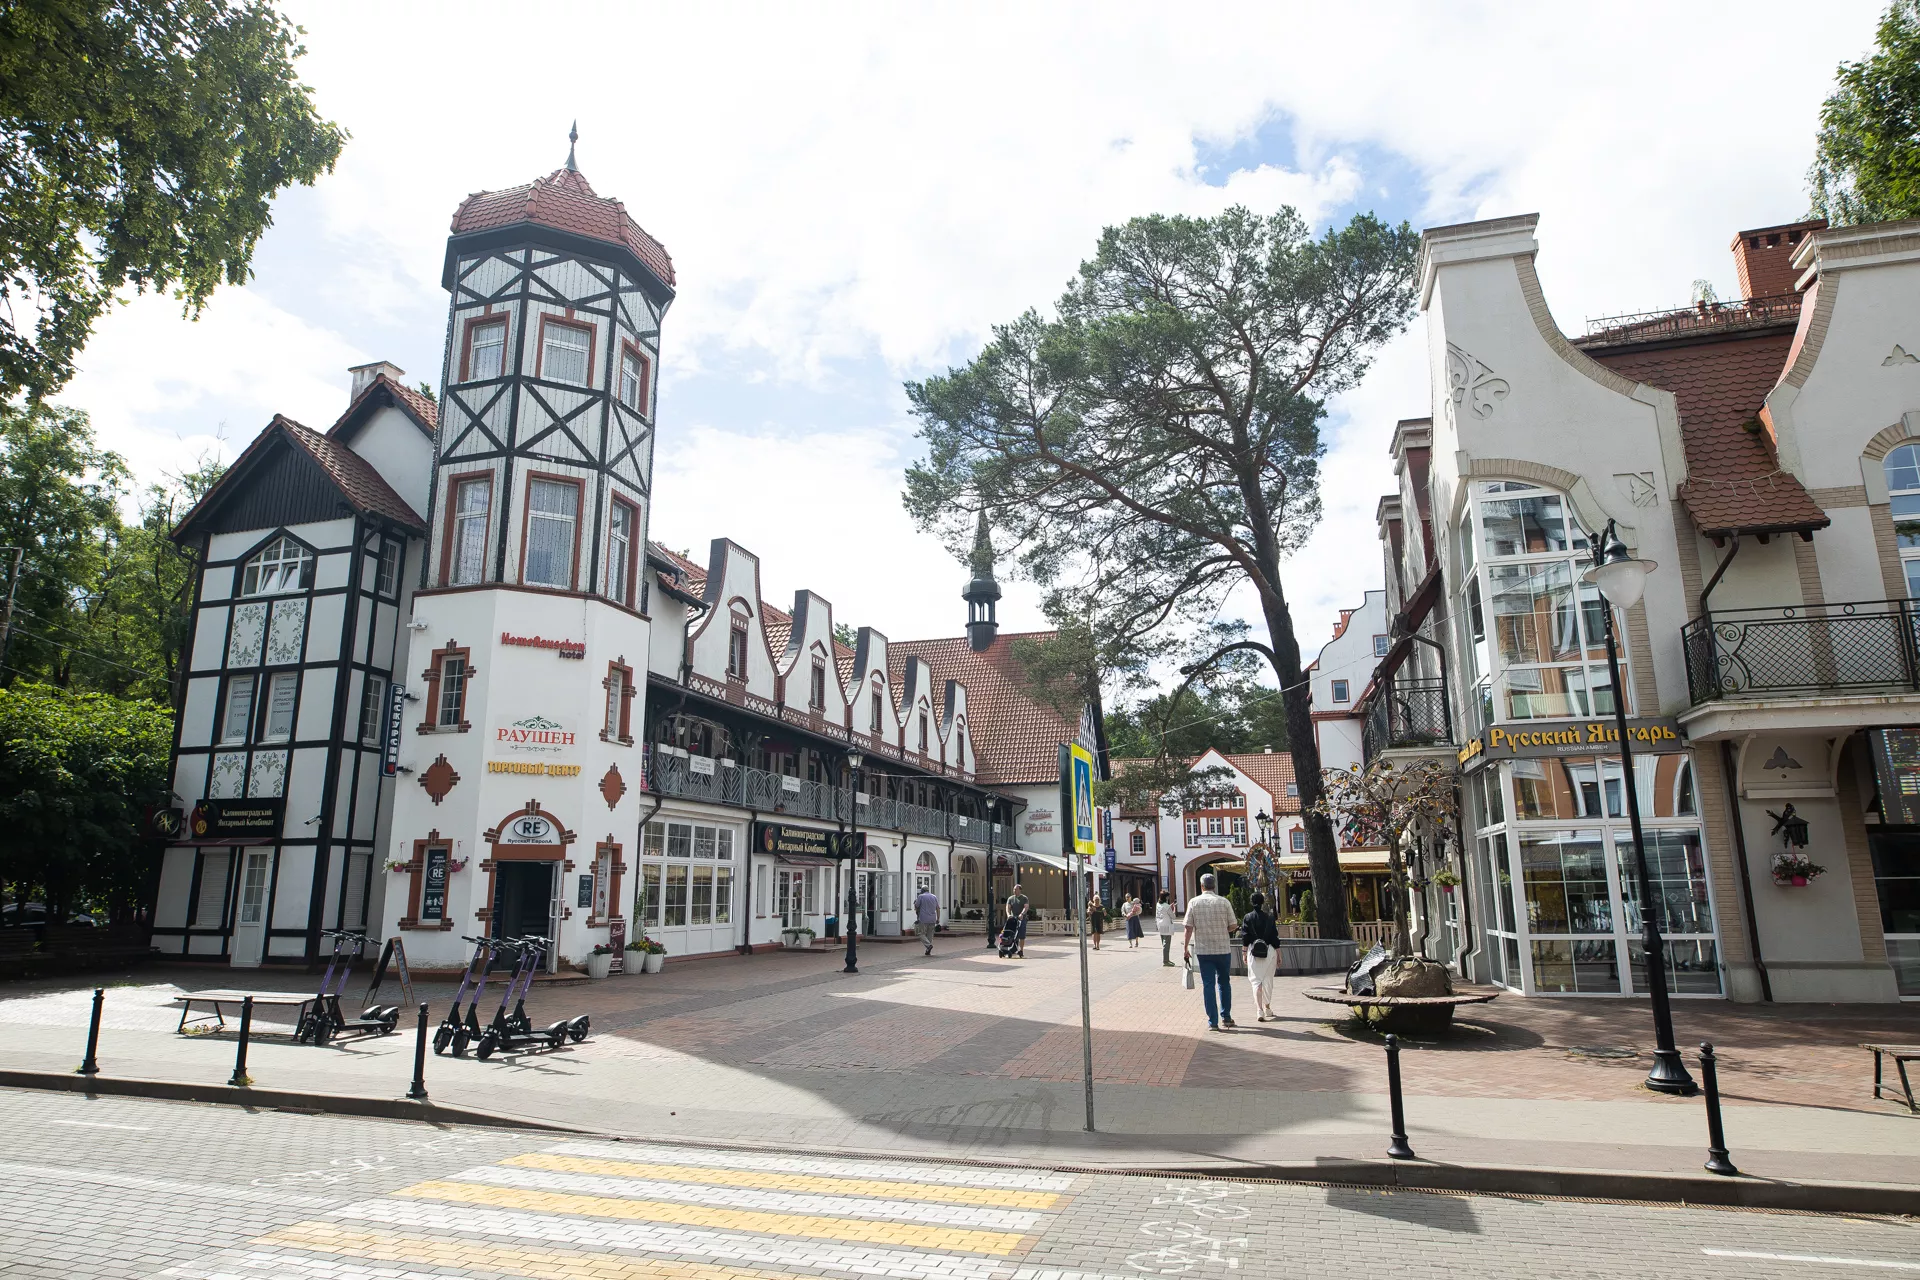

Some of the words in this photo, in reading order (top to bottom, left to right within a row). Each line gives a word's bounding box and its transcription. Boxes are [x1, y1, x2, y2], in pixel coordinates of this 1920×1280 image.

[501, 632, 585, 651] HomeRauschen
[559, 649, 585, 660] hotel
[388, 687, 403, 763] ЭКСКУРСИИ
[497, 728, 576, 745] РАУШЕН
[1490, 725, 1581, 753] Русский
[488, 761, 545, 775] ТОРГОВЫЙ
[548, 763, 582, 777] ЦЕНТР
[222, 808, 273, 818] Калининградский
[217, 818, 246, 828] Янтарный
[246, 818, 274, 827] Комбинат
[523, 821, 542, 834] RE
[781, 826, 826, 842] Калининградский
[777, 840, 804, 854] Янтарный
[804, 842, 827, 855] Комбинат
[432, 868, 444, 878] RE
